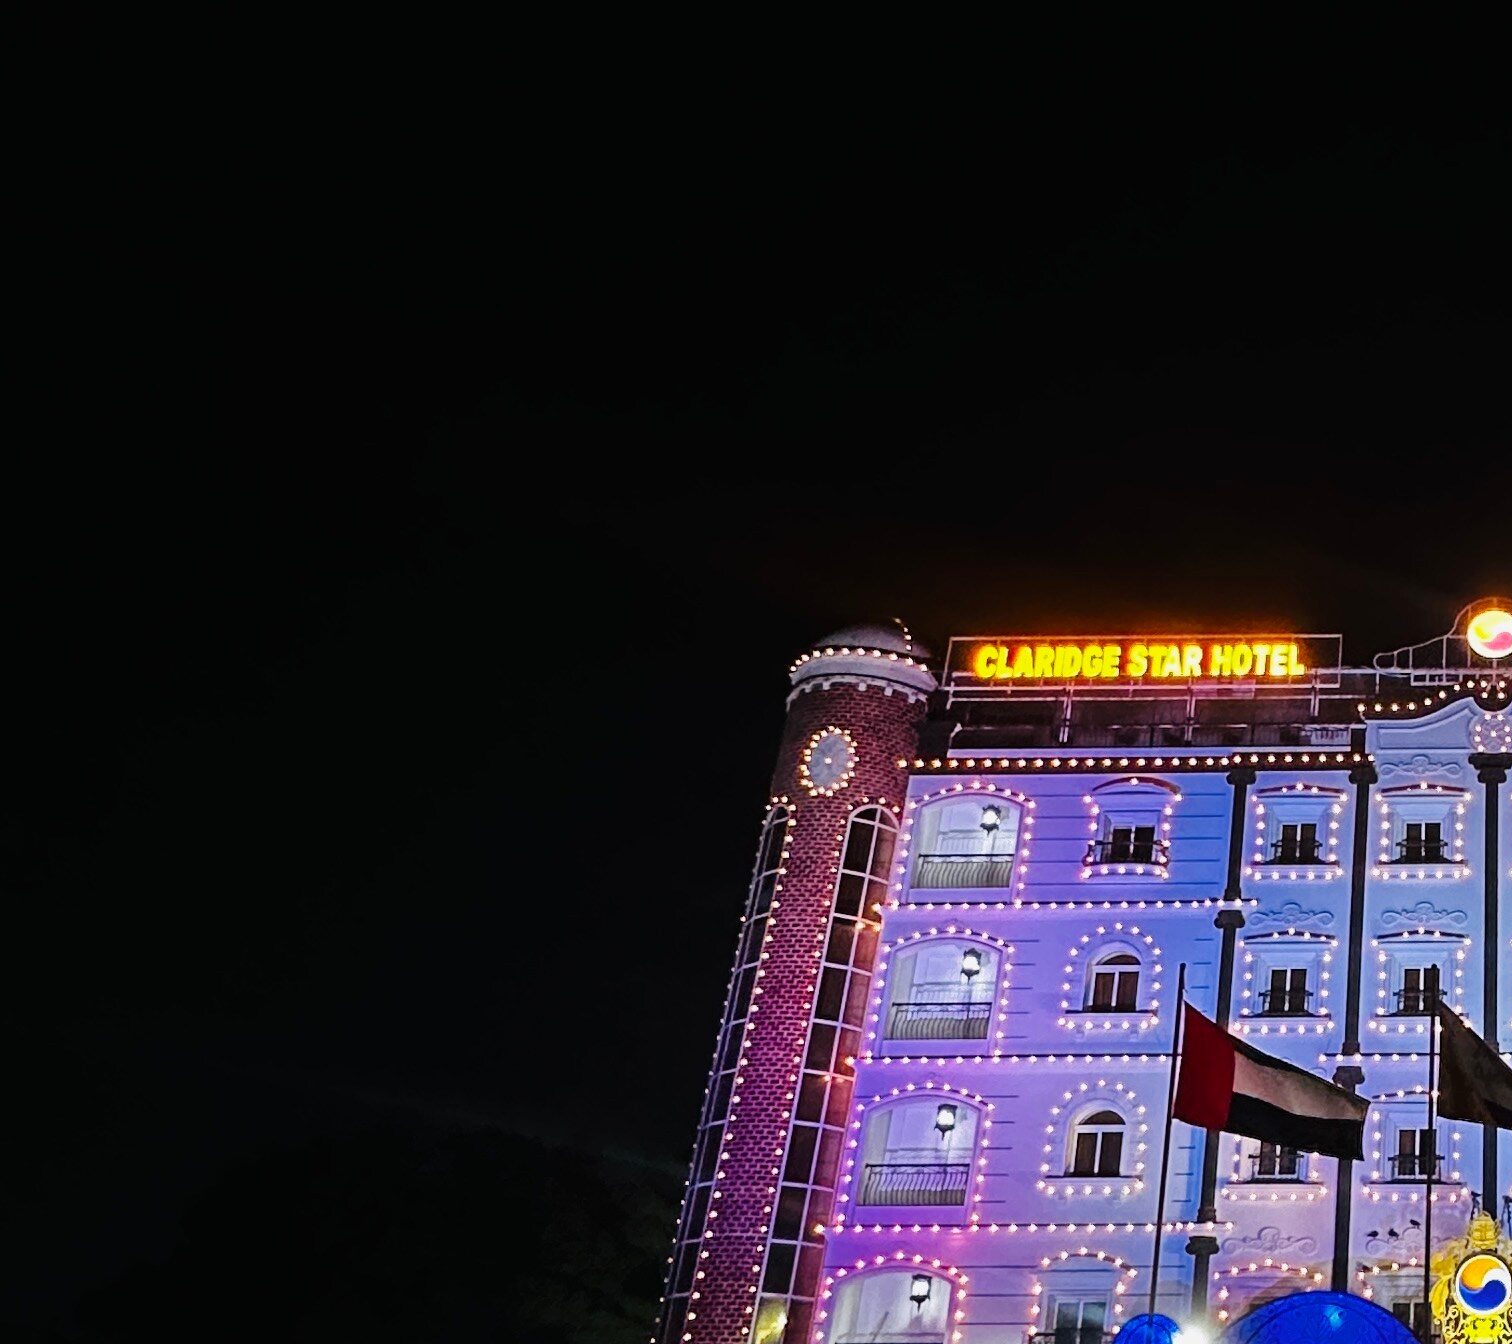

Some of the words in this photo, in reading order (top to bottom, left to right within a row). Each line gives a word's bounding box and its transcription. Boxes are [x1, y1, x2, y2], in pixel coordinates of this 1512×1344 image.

[976, 645, 1122, 679] CLARIDGE
[1127, 644, 1203, 678] STAR
[1210, 643, 1306, 677] HOTEL
